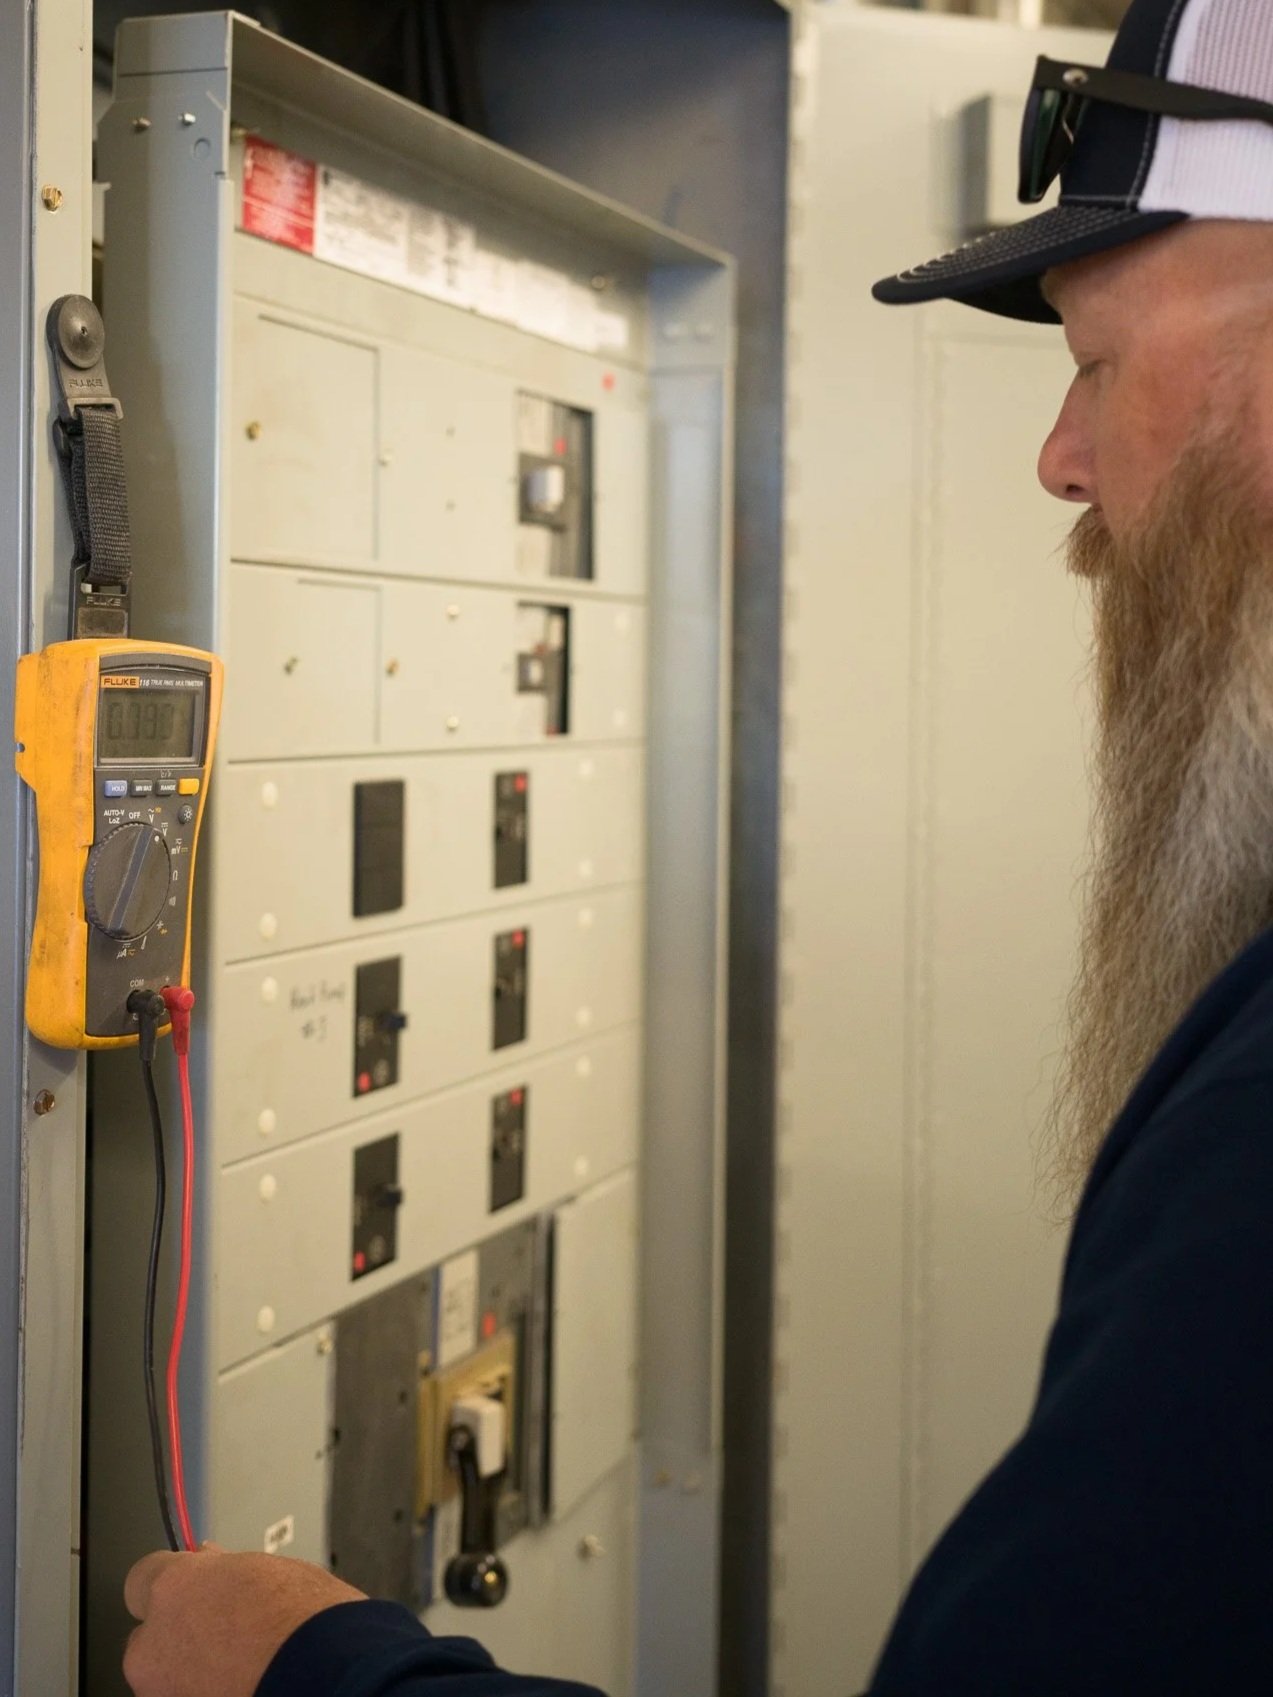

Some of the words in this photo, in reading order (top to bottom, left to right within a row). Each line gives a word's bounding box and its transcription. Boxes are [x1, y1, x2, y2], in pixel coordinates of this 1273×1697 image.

[86, 596, 121, 607] FLUKE
[103, 678, 137, 686] FLUKE
[111, 785, 126, 793] HOLD
[103, 809, 125, 817] AUTO-V
[128, 811, 141, 820] OFF
[108, 817, 120, 825] LoZ
[129, 978, 144, 988] COM
